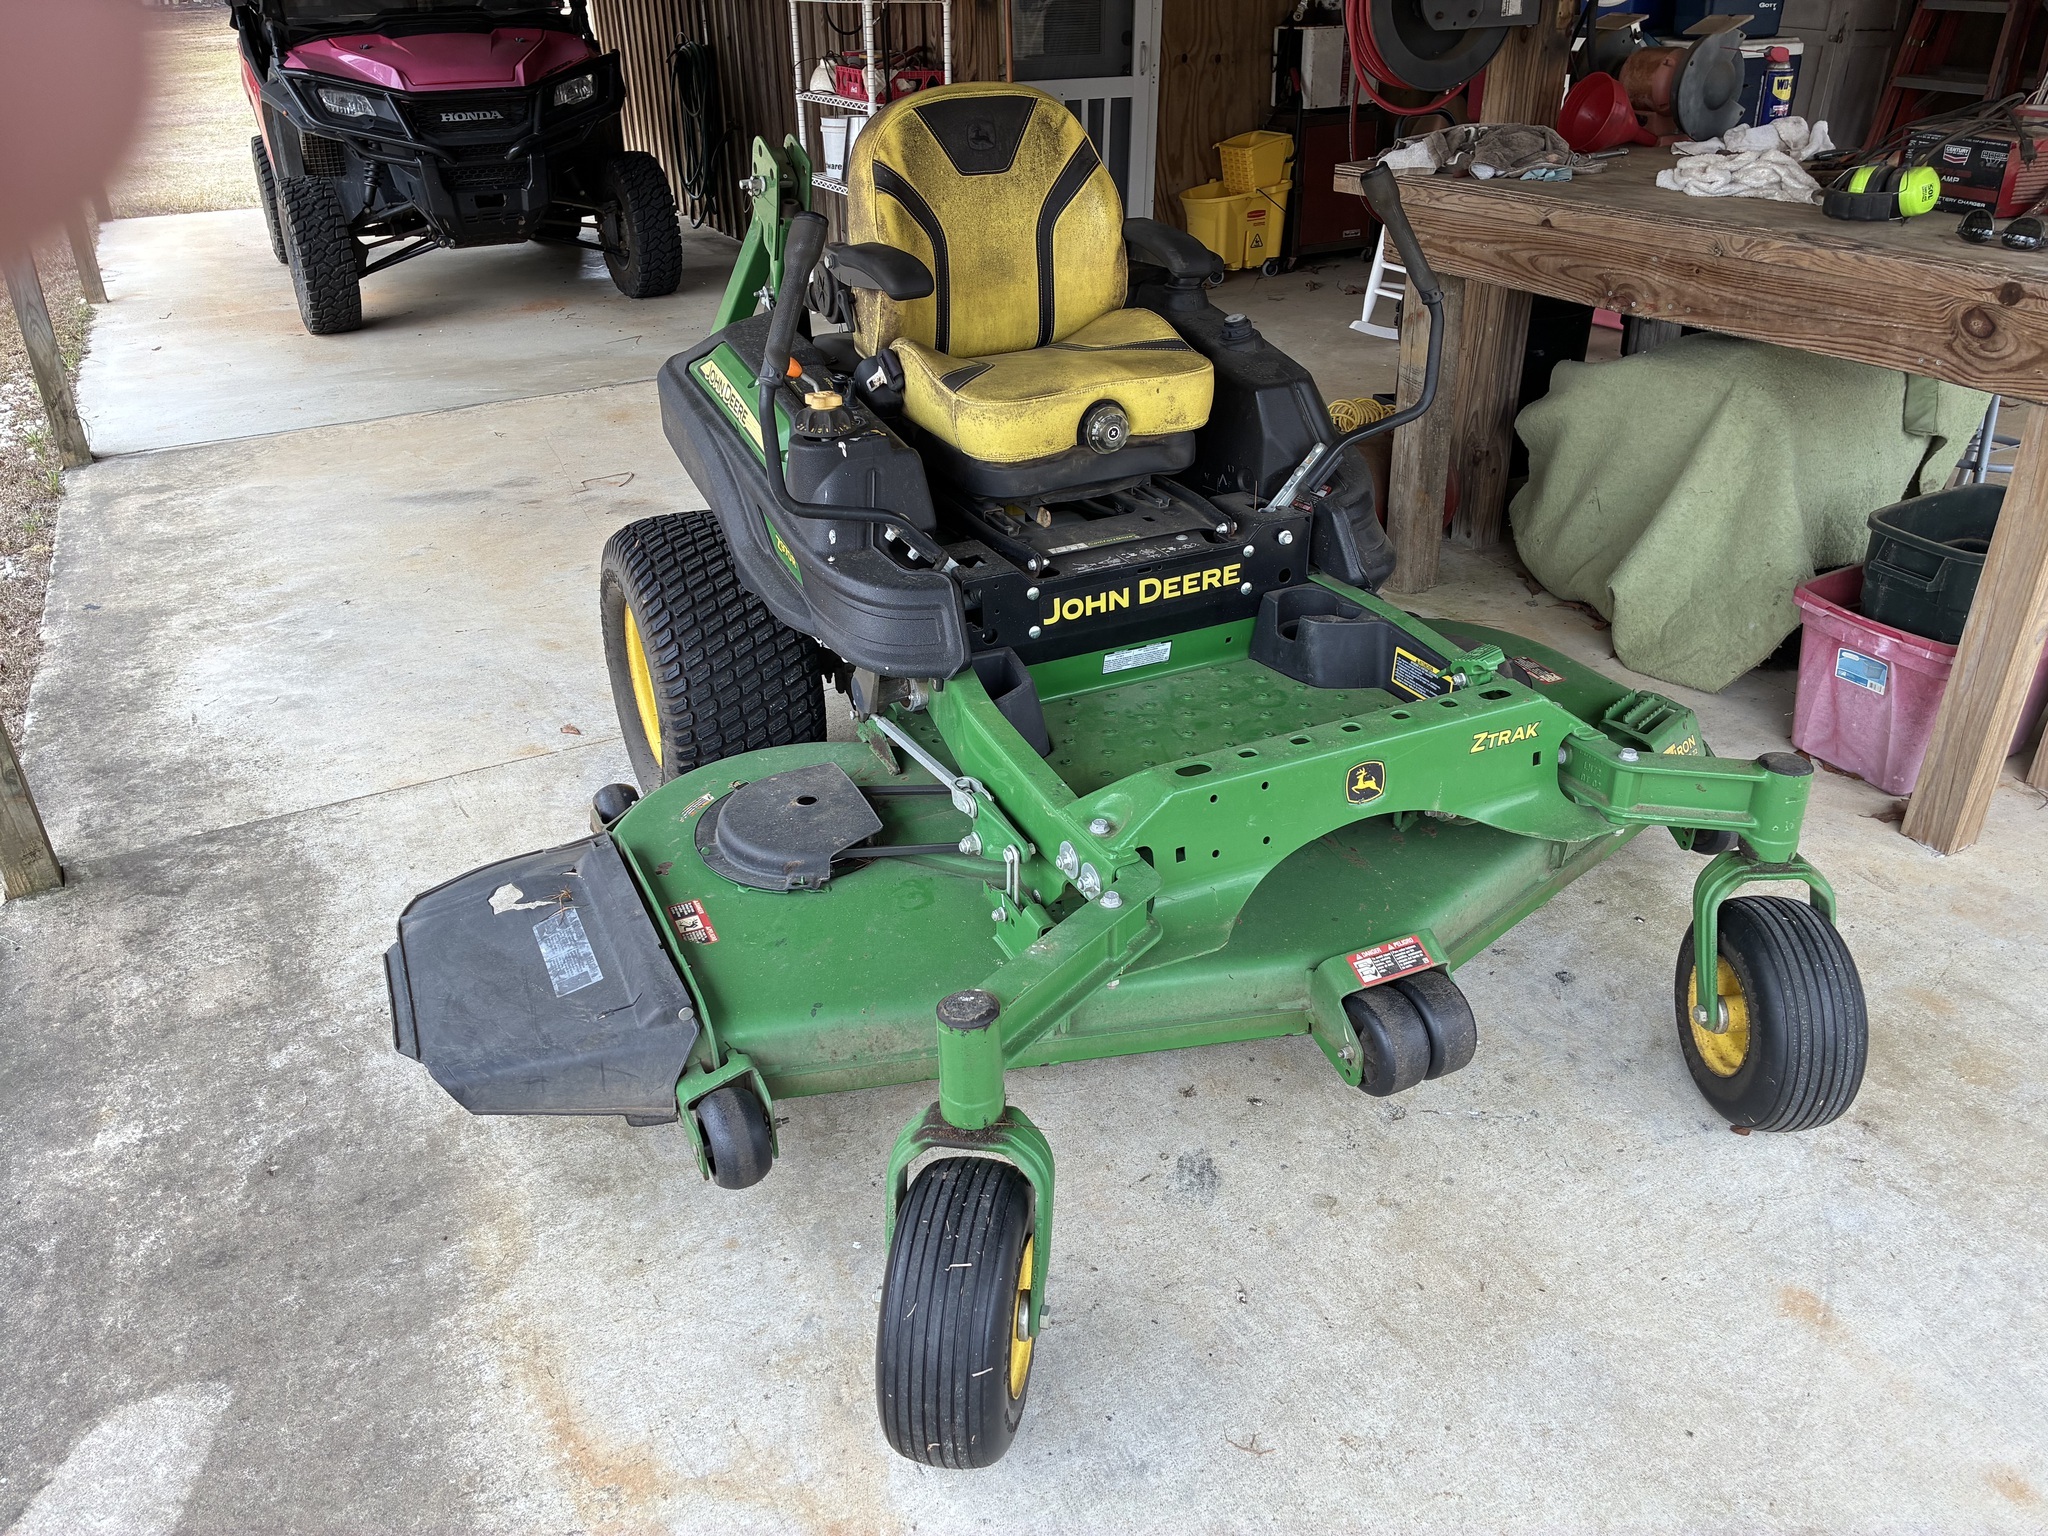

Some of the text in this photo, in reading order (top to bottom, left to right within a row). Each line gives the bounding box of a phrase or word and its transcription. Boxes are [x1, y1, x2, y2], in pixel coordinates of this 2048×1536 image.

[440, 110, 504, 122] HONDA
[1941, 175, 1960, 183] AMP
[705, 363, 749, 426] JOHN DEERE
[1043, 563, 1242, 626] JOHN DEERE
[1469, 720, 1542, 755] ZTRAK
